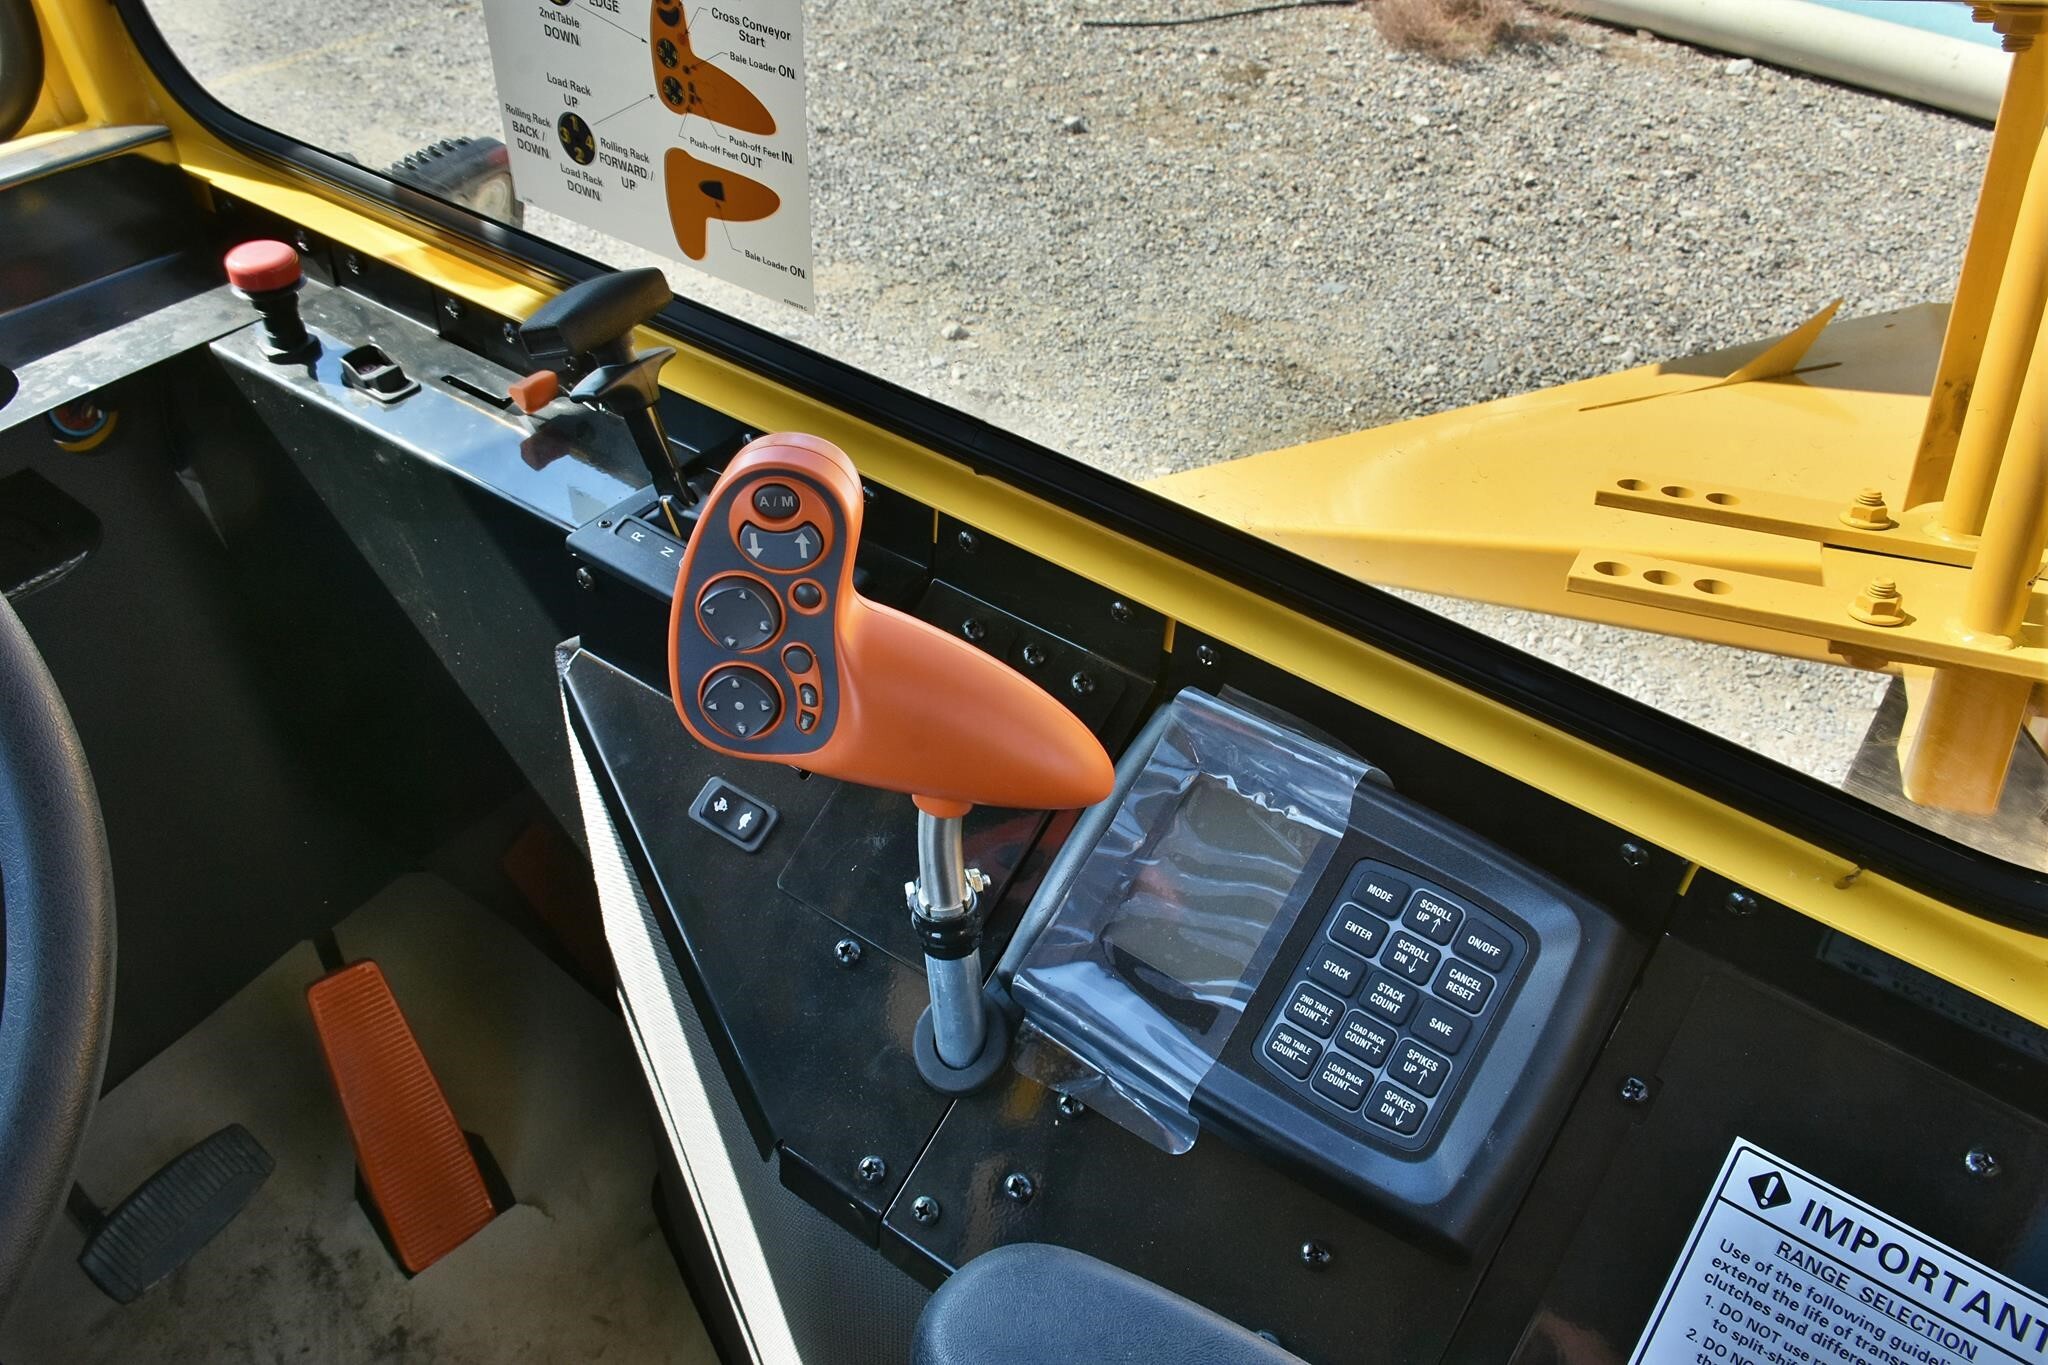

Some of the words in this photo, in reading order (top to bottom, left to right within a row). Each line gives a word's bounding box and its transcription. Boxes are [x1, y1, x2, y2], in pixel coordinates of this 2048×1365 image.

[539, 7, 555, 21] 2nd
[556, 11, 579, 28] Table
[711, 7, 740, 25] Cross
[742, 17, 791, 40] Conveyor
[544, 24, 580, 46] DOWN
[738, 30, 765, 47] Start
[729, 51, 746, 64] Bale
[749, 57, 776, 73] Loader
[778, 64, 795, 79] ON
[546, 72, 567, 88] Load
[570, 80, 591, 96] Rack
[563, 93, 578, 106] UP
[505, 103, 531, 123] Rolling
[533, 113, 551, 128] Rack
[517, 138, 550, 159] DOWN
[600, 137, 628, 157] Rolling
[630, 148, 650, 164] Rack
[690, 137, 721, 154] Push-off
[723, 148, 739, 160] Feet
[741, 153, 763, 168] OUT
[729, 135, 761, 153] Push-off
[763, 146, 780, 160] Feet
[781, 151, 793, 164] IN
[560, 163, 580, 178] Load
[583, 172, 603, 187] Rack
[621, 176, 636, 190] UP
[567, 180, 601, 201] DOWN
[745, 249, 760, 262] Bale
[762, 256, 788, 272] Loader
[790, 265, 805, 279] ON
[630, 531, 645, 542] R
[660, 546, 675, 558] N
[1367, 884, 1394, 903] MODE
[1416, 911, 1430, 922] UP
[1420, 898, 1452, 922] SCROLL
[1345, 920, 1373, 941] ENTER
[1394, 951, 1408, 964] DN
[1397, 939, 1430, 963] SCROLL
[1468, 935, 1501, 957] ON/OFF
[1323, 960, 1352, 981] STACK
[1449, 968, 1481, 992] CANCEL
[1377, 982, 1406, 1003] STACK
[1446, 981, 1475, 1002] RESET
[1299, 994, 1314, 1006] 2ND
[1314, 1001, 1334, 1017] TABLE
[1370, 992, 1401, 1015] COUNT
[1349, 1021, 1367, 1036] LOAD
[1368, 1031, 1387, 1047] RACK
[1429, 1017, 1453, 1036] SAVE
[1277, 1032, 1292, 1044] 2ND
[1292, 1040, 1312, 1055] TABLE
[1403, 1061, 1417, 1074] UP
[1406, 1048, 1439, 1072] SPIKES
[1327, 1062, 1345, 1076] LOAD
[1345, 1071, 1364, 1087] RACK
[1380, 1102, 1396, 1117] DN
[1384, 1090, 1416, 1114] SPIKES
[1712, 1257, 1770, 1294] extend
[1773, 1289, 1799, 1311] the
[1803, 1305, 1829, 1328] life
[1834, 1325, 1853, 1340] of
[1720, 1238, 1750, 1264] Use
[1754, 1262, 1774, 1275] of
[1775, 1271, 1802, 1292] the
[1808, 1287, 1886, 1342] following
[1776, 1241, 1851, 1291] RANGE
[1859, 1287, 1978, 1360] SELECTION
[1704, 1271, 1772, 1316] clutches
[1775, 1311, 1808, 1336] and
[1705, 1295, 1714, 1309] 1.
[1719, 1302, 1743, 1323] DO
[1746, 1318, 1782, 1344] NOT
[1783, 1342, 1810, 1361] use
[1712, 1319, 1728, 1334] to
[1686, 1328, 1698, 1343] 2.
[1703, 1337, 1727, 1357] DO
